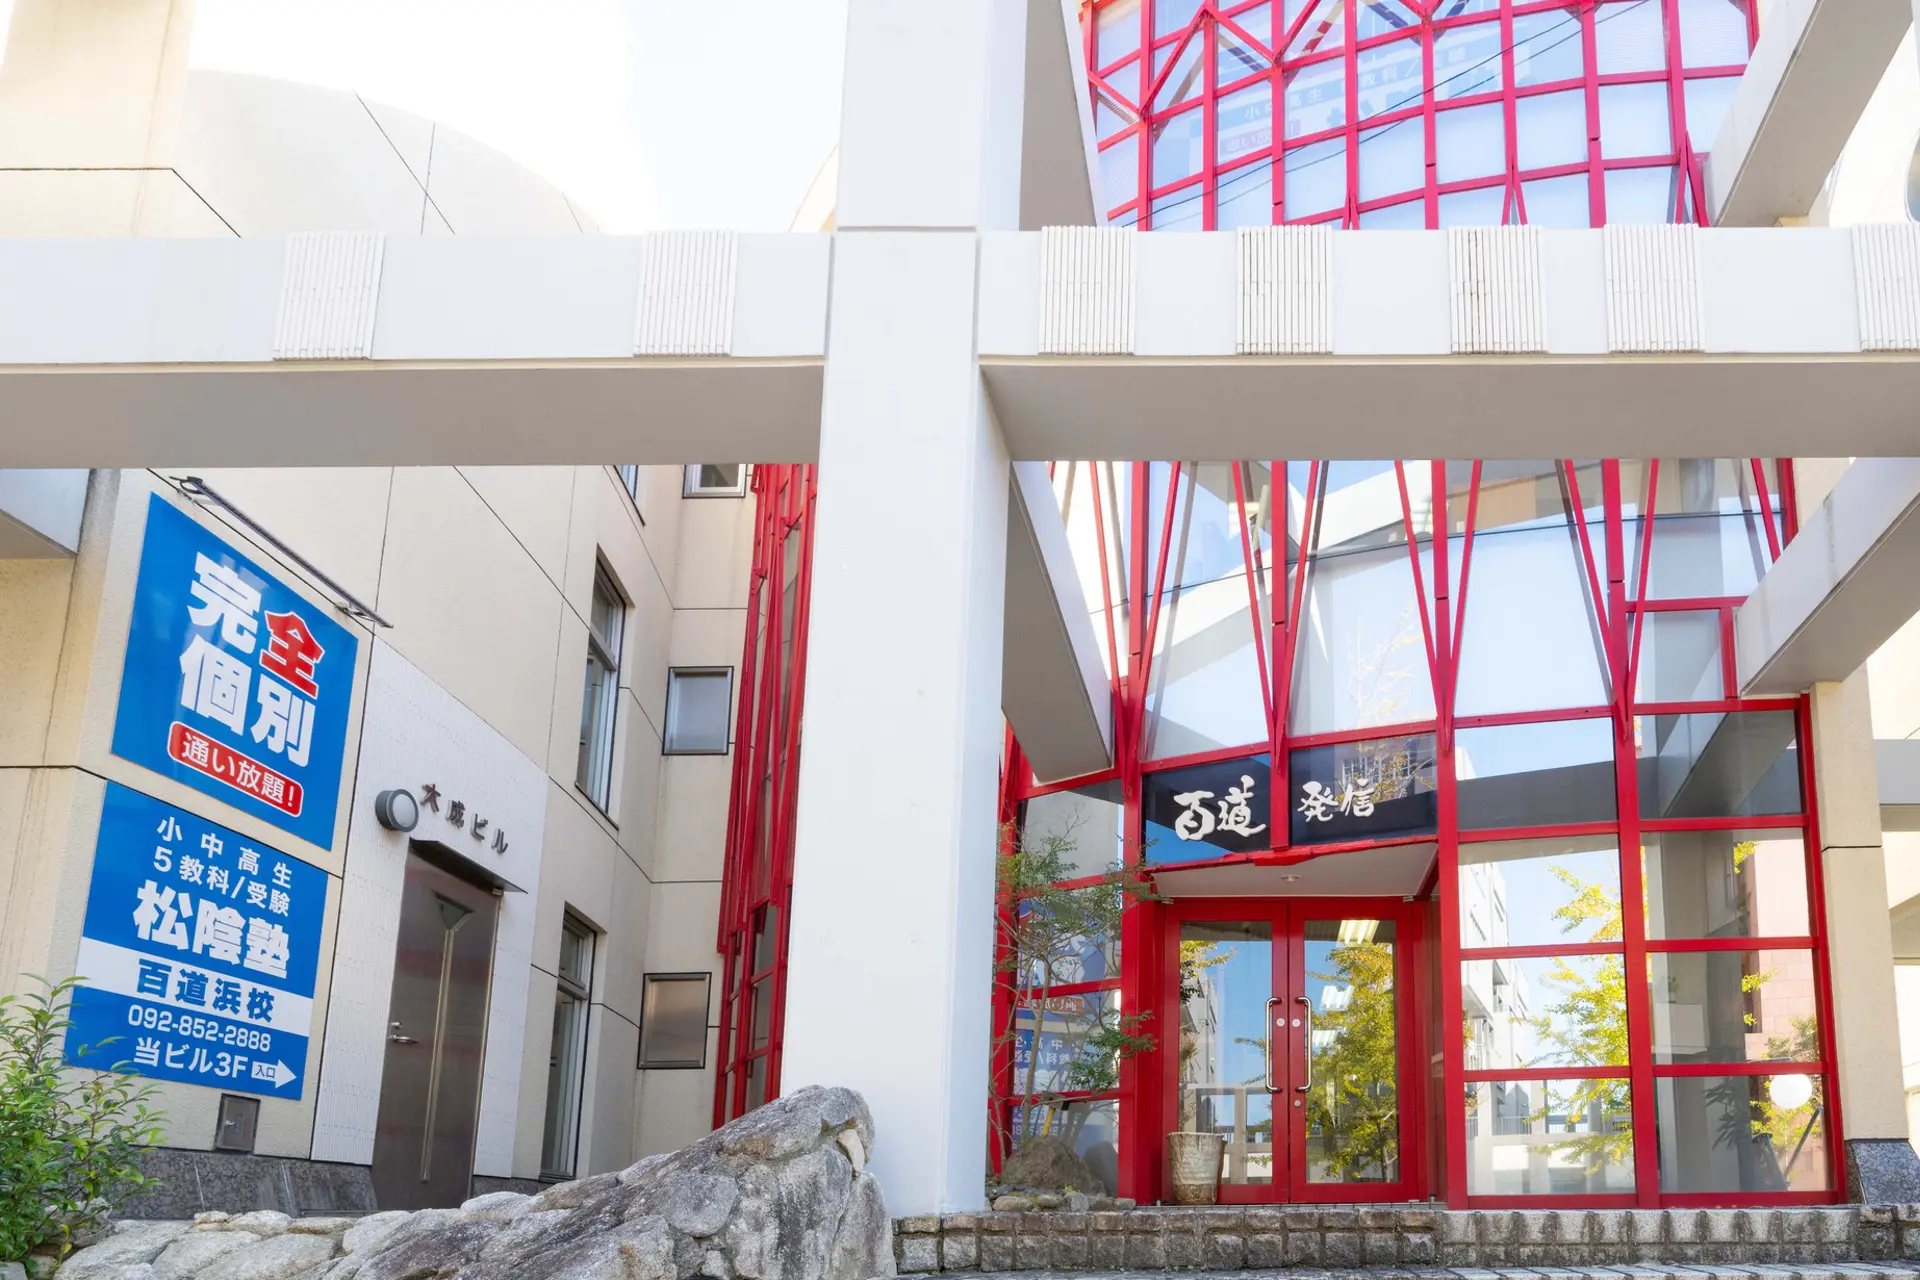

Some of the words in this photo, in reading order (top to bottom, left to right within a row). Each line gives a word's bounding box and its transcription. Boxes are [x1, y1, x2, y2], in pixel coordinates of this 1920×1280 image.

[187, 551, 325, 700] 完全
[179, 634, 316, 767] 個別
[1173, 774, 1267, 841] 百道
[1297, 778, 1375, 823] 発信
[153, 847, 291, 917] 5教科/受験
[132, 879, 291, 979] 松陰塾
[136, 958, 275, 1023] 百道浜校
[128, 1004, 272, 1052] 092-852-2888
[133, 1037, 249, 1079] 当ビル3F
[255, 1063, 276, 1079] 入口
